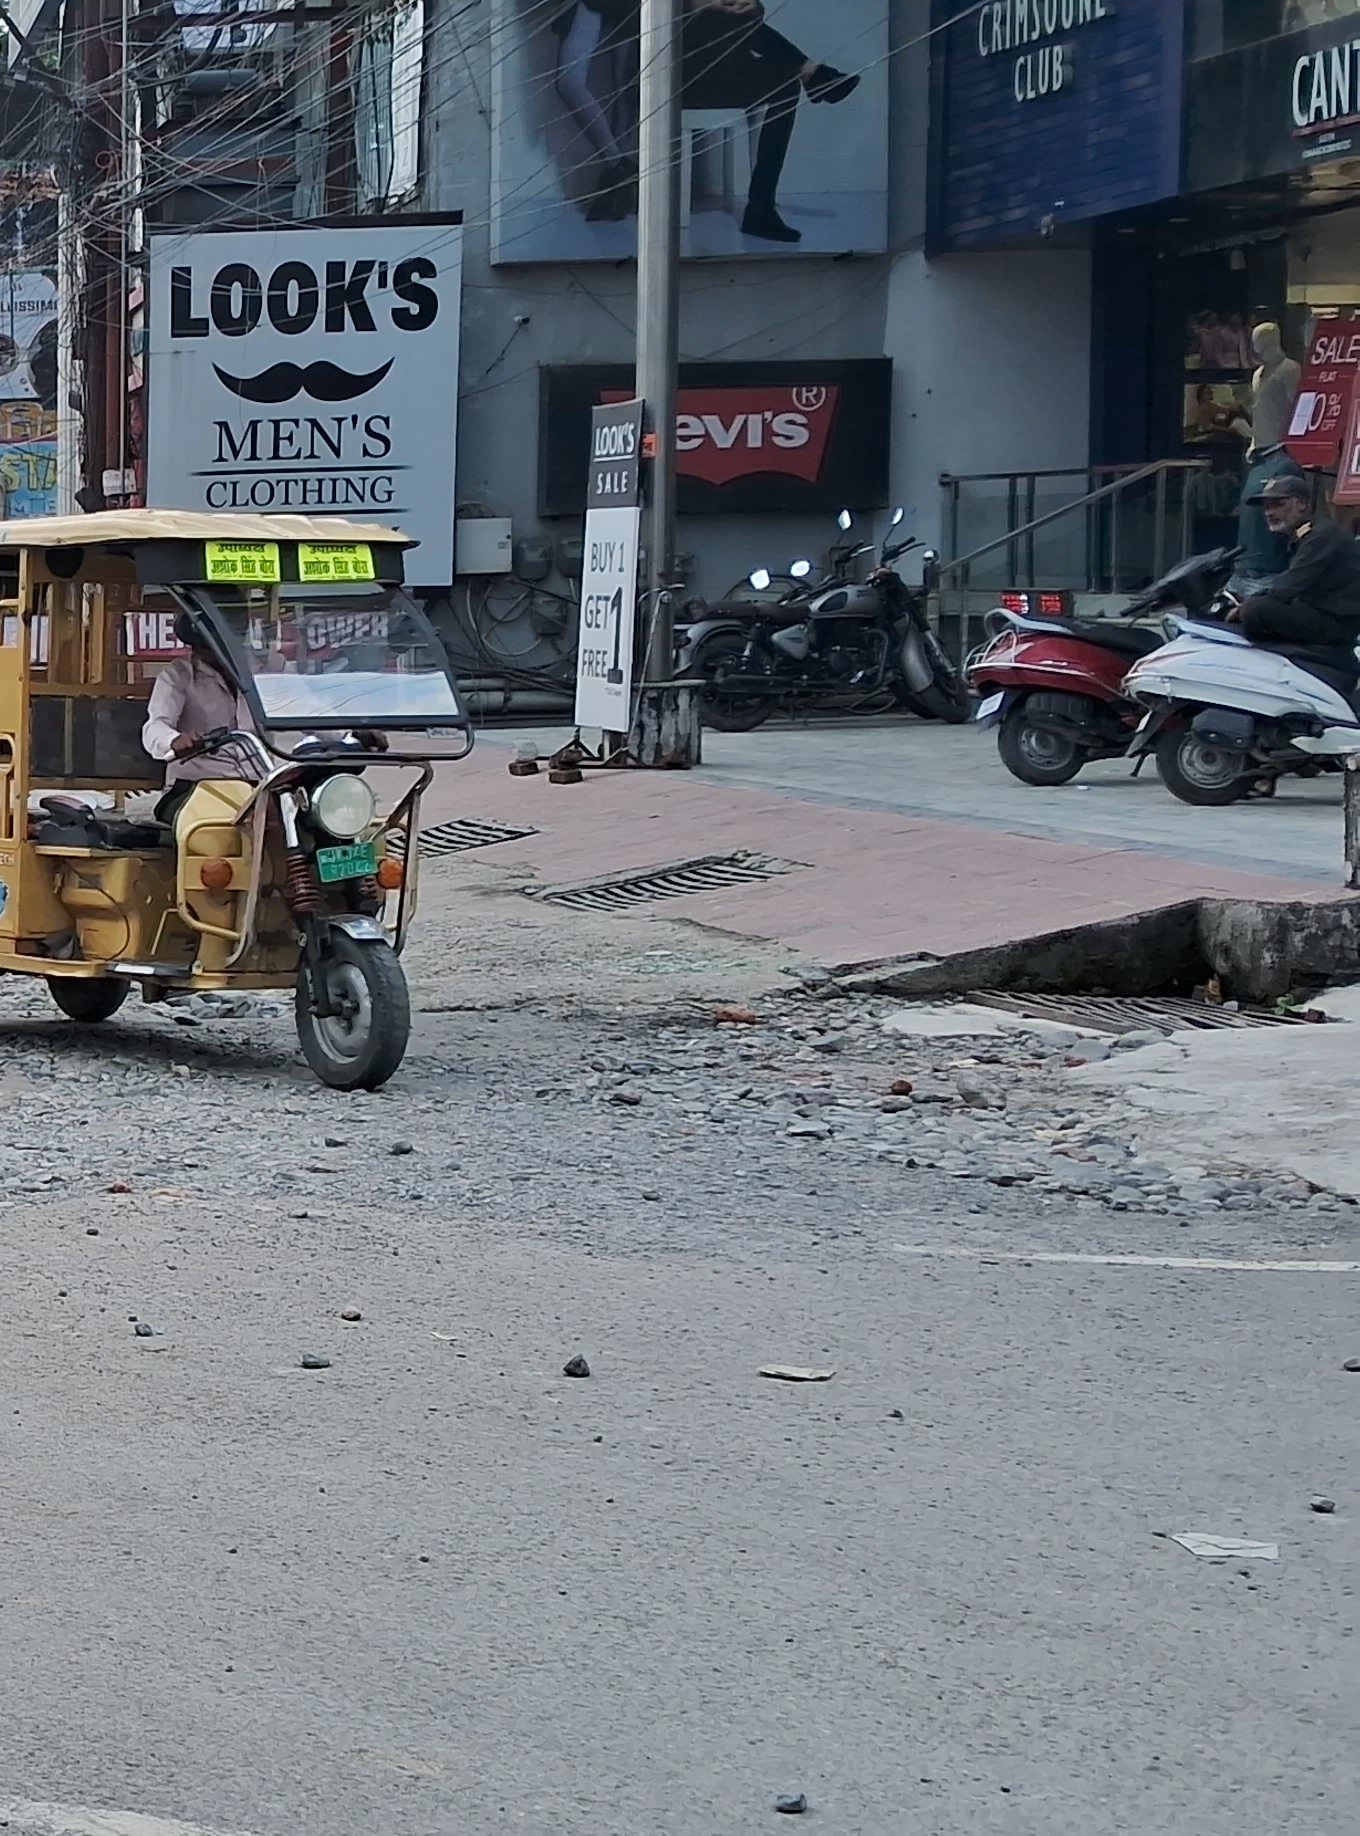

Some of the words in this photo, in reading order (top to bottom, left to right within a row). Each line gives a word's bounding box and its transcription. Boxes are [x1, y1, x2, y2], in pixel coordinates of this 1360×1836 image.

[1014, 44, 1064, 102] CLUB
[170, 257, 439, 338] LOOK'S
[1311, 334, 1360, 365] SALE
[212, 414, 392, 463] MEN'S
[595, 422, 635, 457] LOOK'S
[676, 411, 810, 451] evi's
[205, 476, 396, 509] CLOTHING
[596, 470, 629, 494] SALE
[591, 542, 616, 574] BUY
[617, 541, 625, 573] 1
[584, 595, 611, 630] GET
[582, 648, 608, 679] FREE
